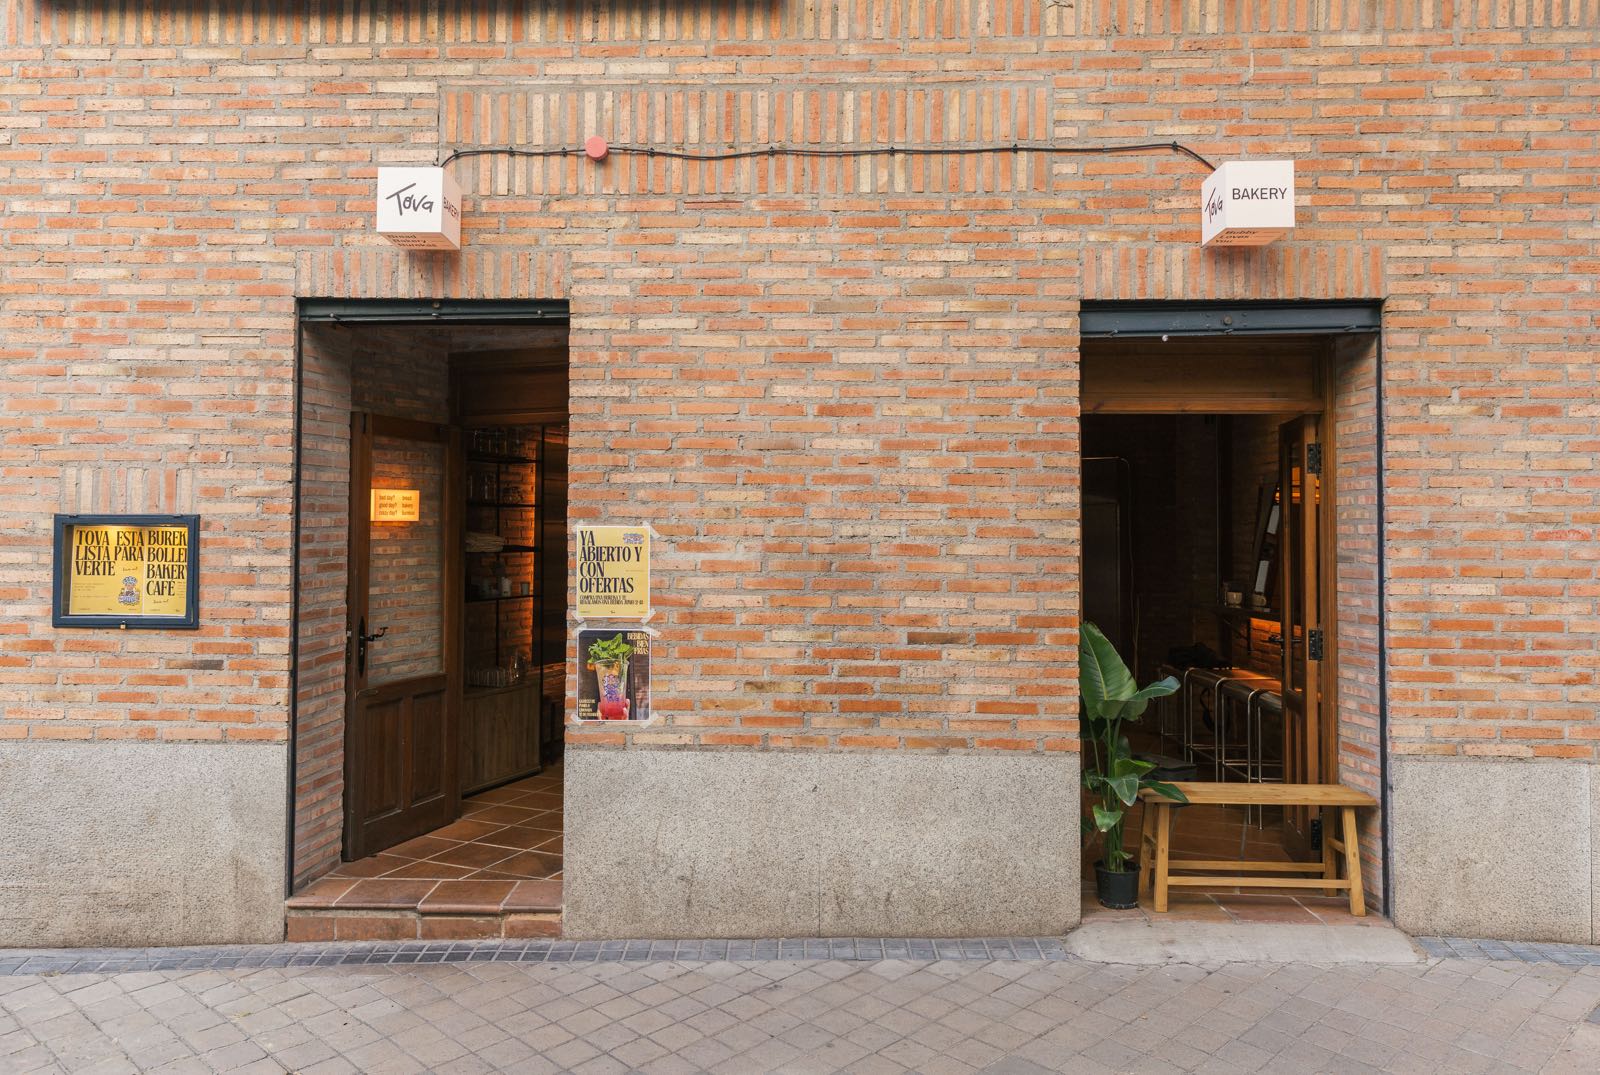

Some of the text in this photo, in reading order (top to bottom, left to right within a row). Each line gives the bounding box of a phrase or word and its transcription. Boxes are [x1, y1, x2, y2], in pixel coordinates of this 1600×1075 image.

[385, 182, 434, 216] Tova
[1232, 187, 1287, 200] BAKERY
[1205, 187, 1223, 224] Tova
[77, 529, 110, 546] TOVA
[579, 530, 595, 546] YA
[75, 545, 144, 561] LISTA PARA
[579, 546, 643, 562] ABIERTO Y
[75, 560, 116, 576] VERTE
[579, 562, 605, 578] CON
[579, 577, 634, 594] OFERTAS
[627, 632, 649, 640] BEBIDAS
